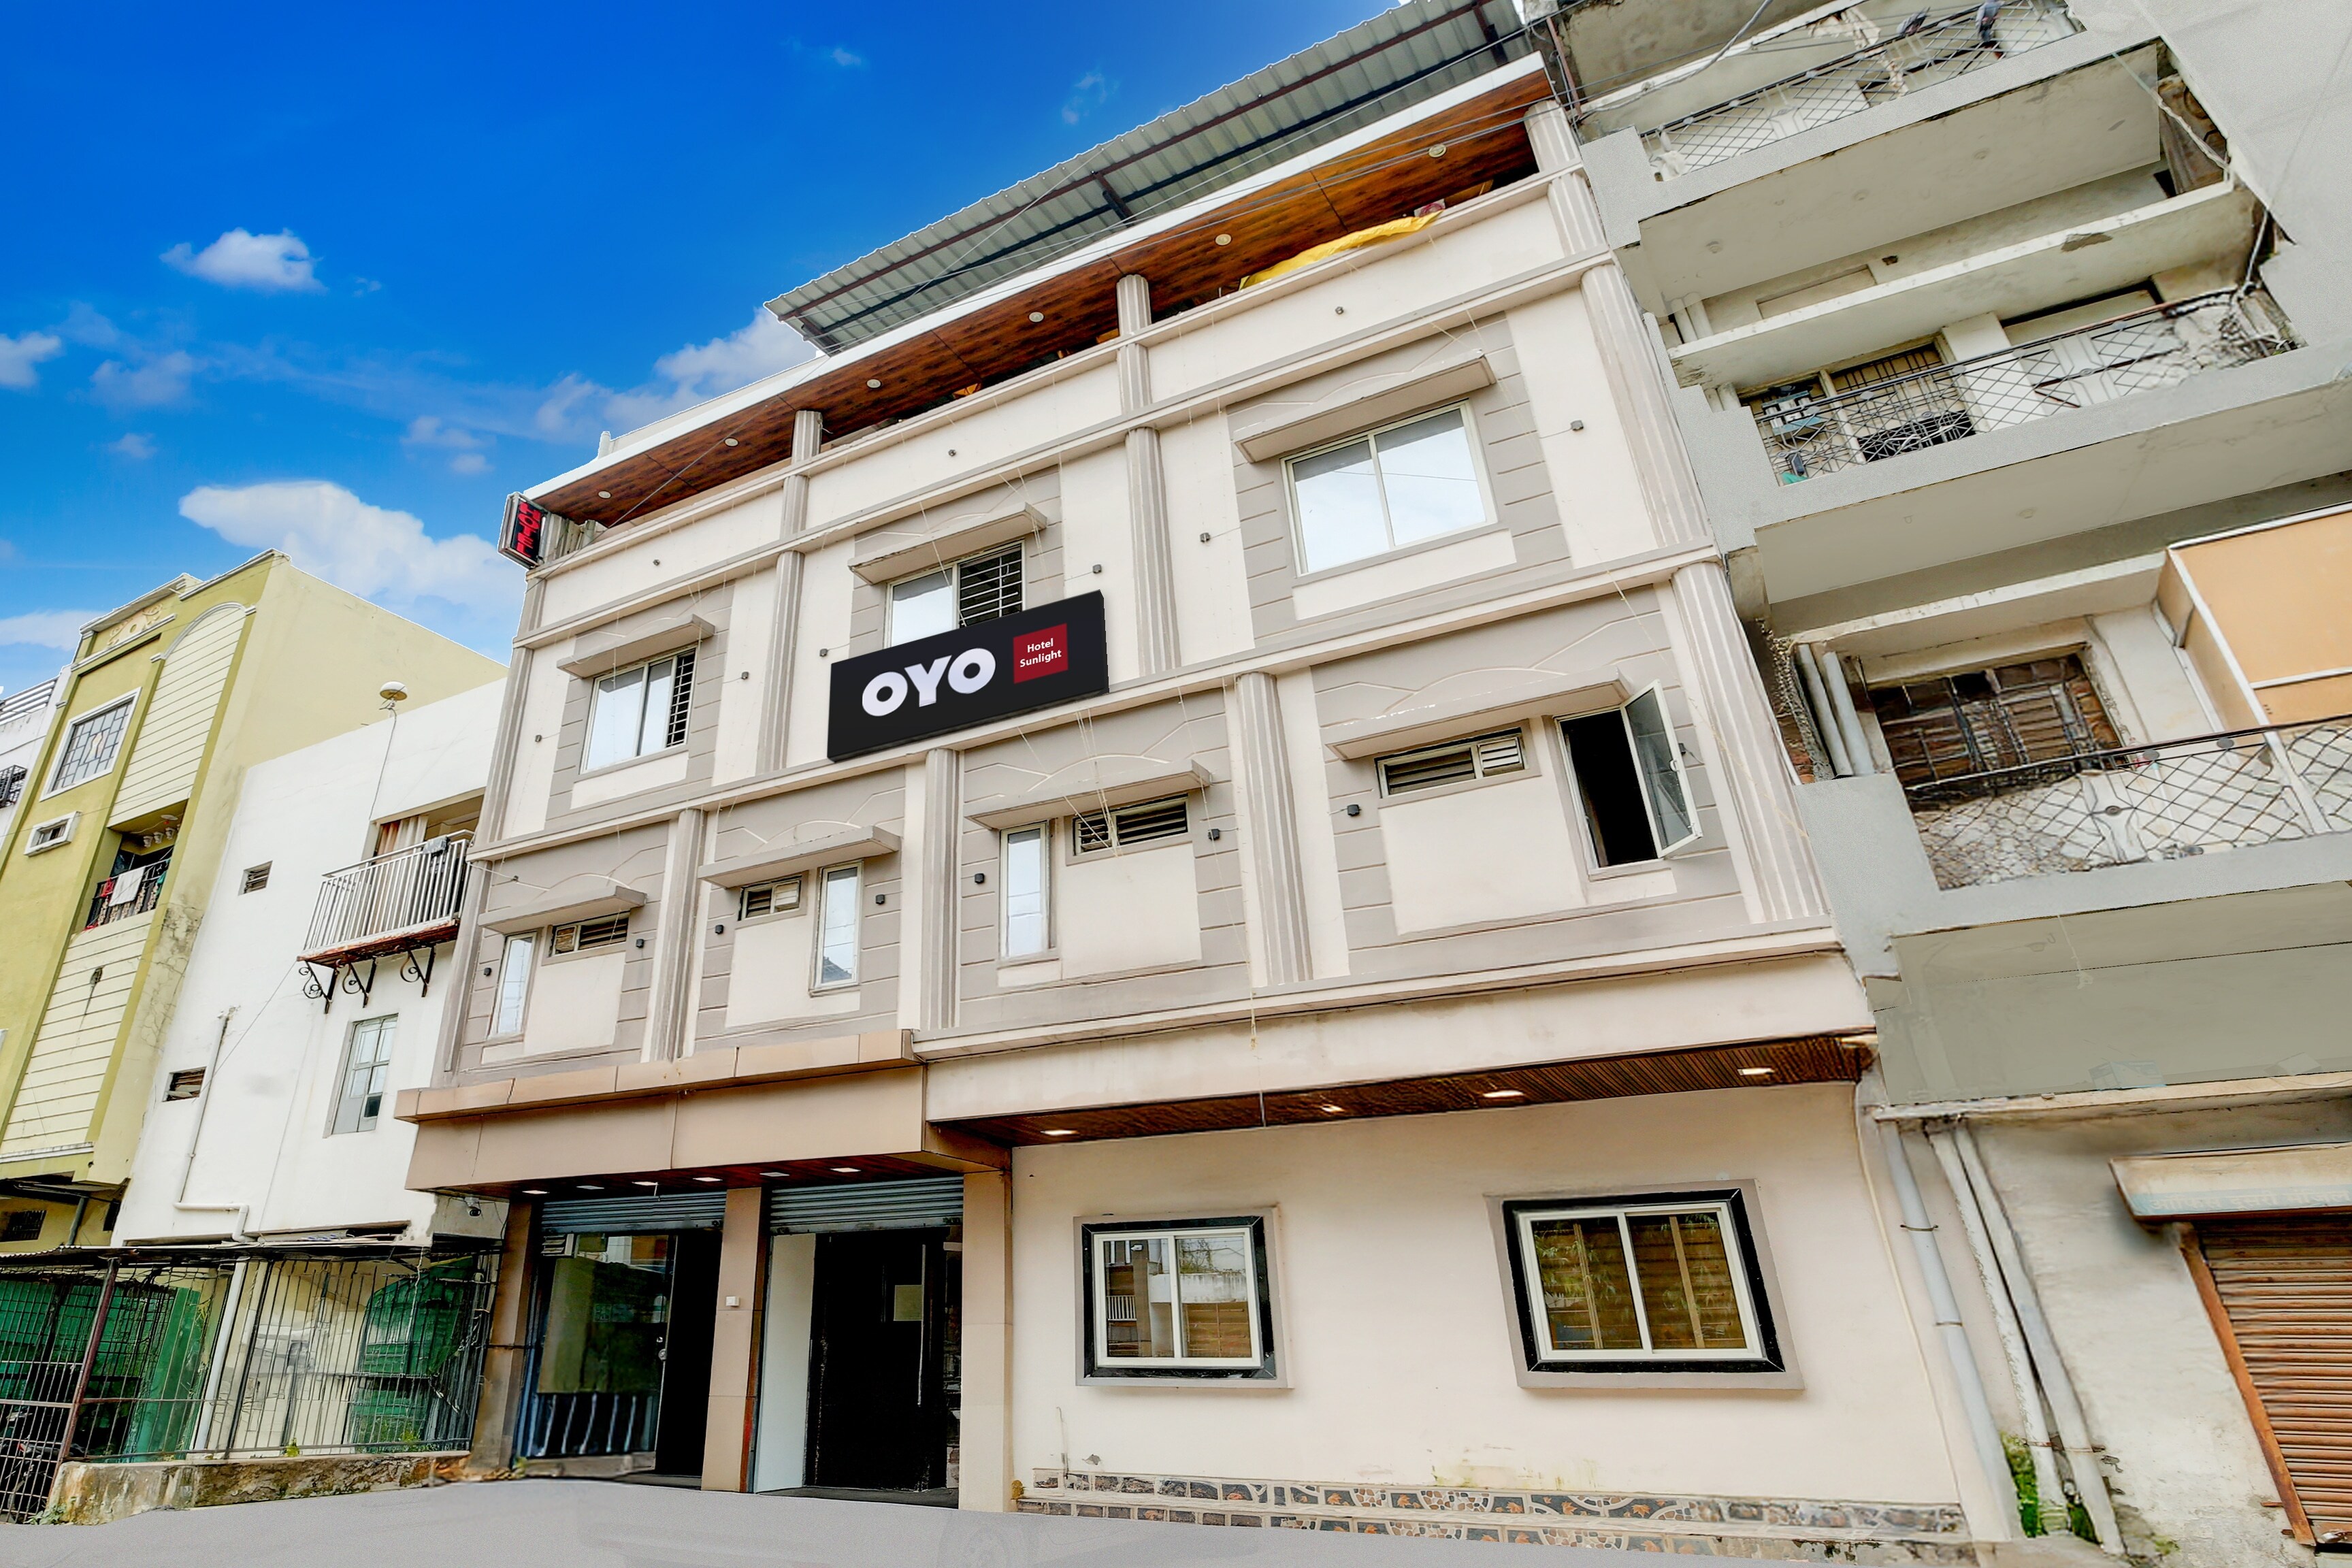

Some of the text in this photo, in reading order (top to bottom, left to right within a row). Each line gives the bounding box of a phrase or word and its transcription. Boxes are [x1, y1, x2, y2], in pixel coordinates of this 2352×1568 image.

[516, 502, 542, 557] HOTEL
[1019, 650, 1062, 668] Sunlight
[1027, 638, 1054, 653] Hotel
[862, 648, 996, 717] OYO
